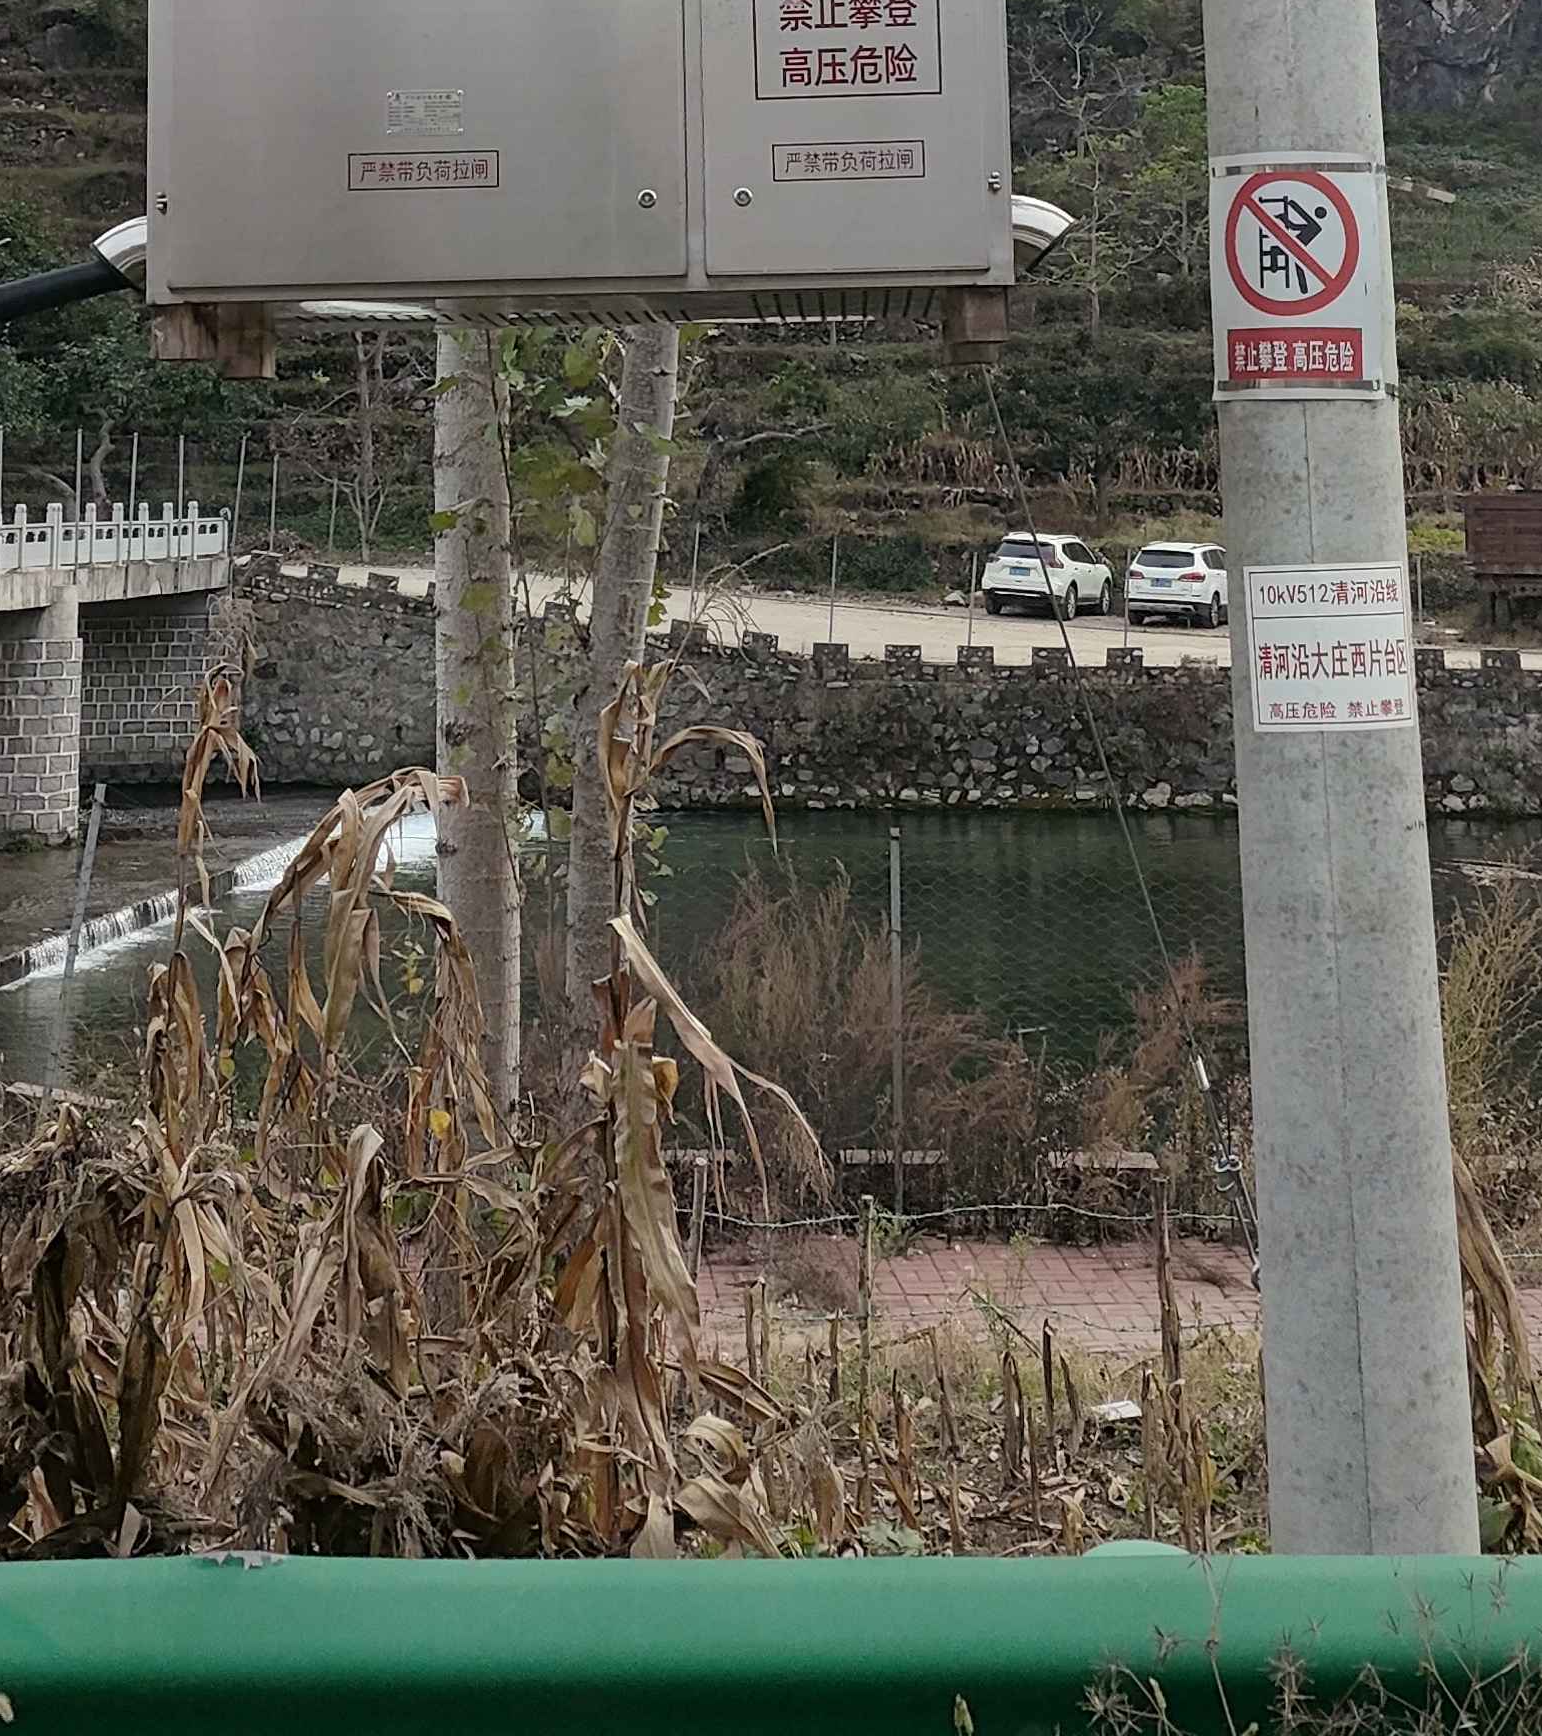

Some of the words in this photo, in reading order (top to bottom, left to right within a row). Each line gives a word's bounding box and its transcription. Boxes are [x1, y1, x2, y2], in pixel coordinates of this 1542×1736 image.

[779, 43, 918, 88] 高压危险
[360, 158, 489, 184] 严禁带负荷拉闸
[785, 148, 914, 174] 严禁带负荷拉闸
[1234, 340, 1288, 372] 禁止攀登
[1292, 340, 1354, 372] 高压危险
[1259, 579, 1400, 606] 10kV512清河沿线
[1259, 639, 1408, 681] 清河沿大庄西片台区
[1269, 701, 1337, 721] 高压危险
[1347, 697, 1404, 719] 禁止攀登
